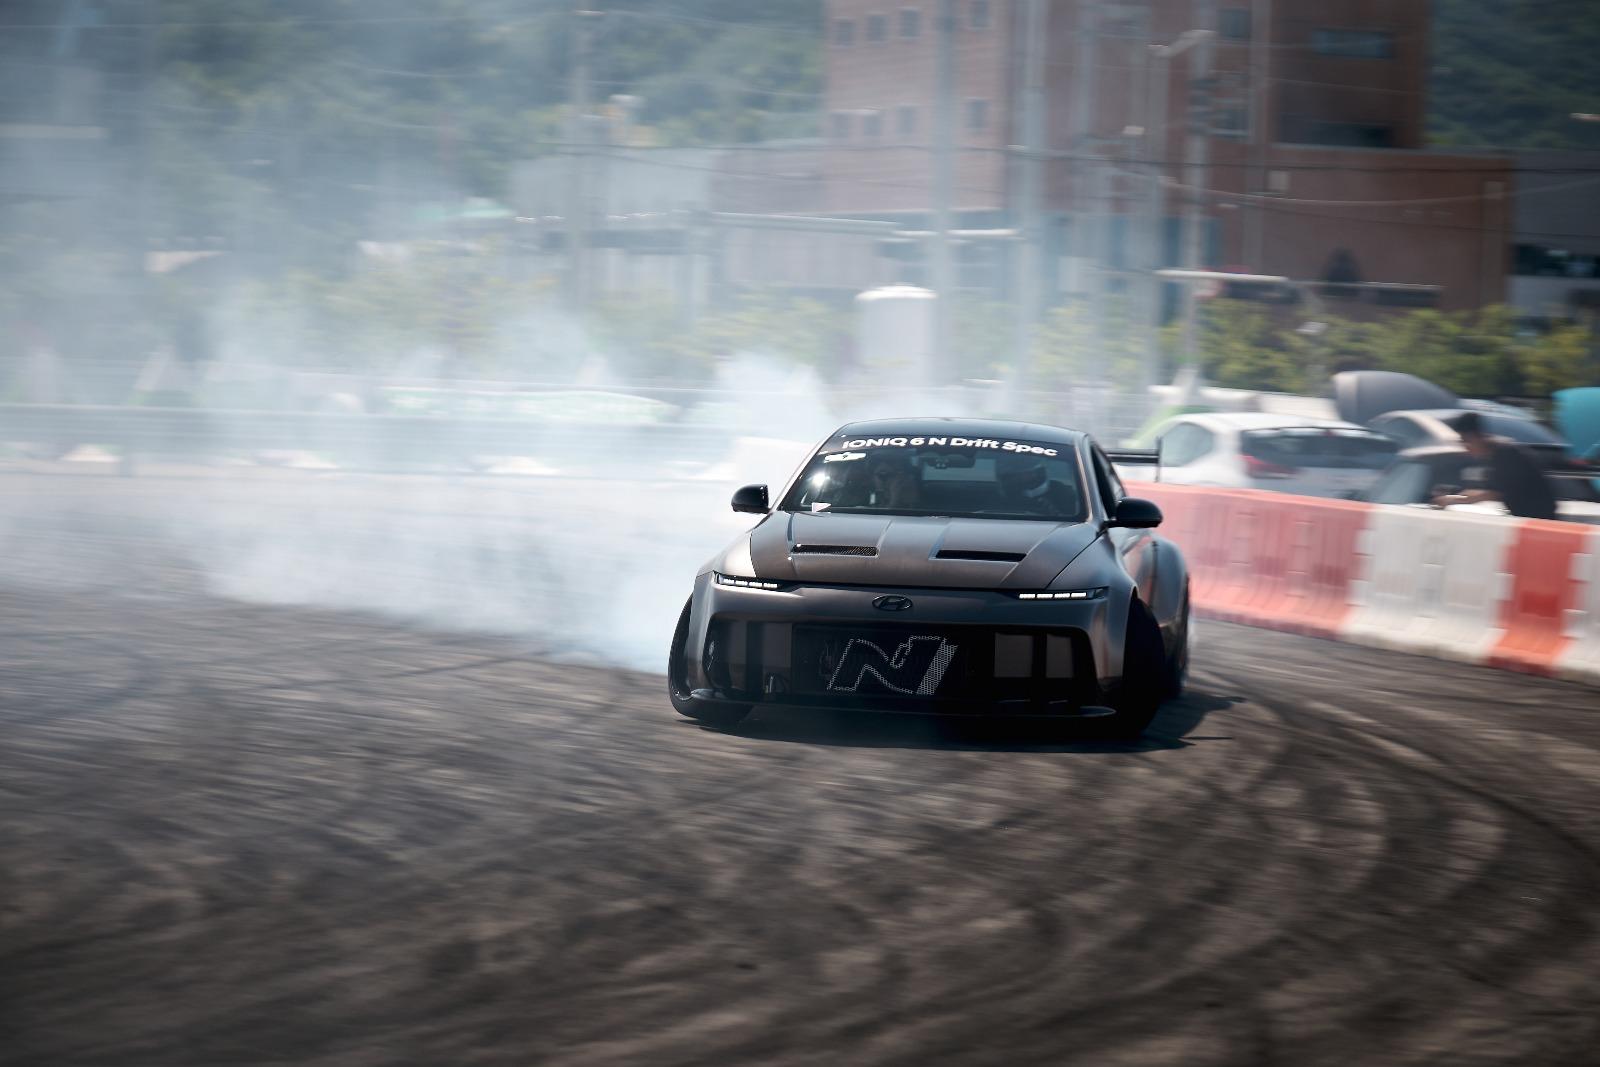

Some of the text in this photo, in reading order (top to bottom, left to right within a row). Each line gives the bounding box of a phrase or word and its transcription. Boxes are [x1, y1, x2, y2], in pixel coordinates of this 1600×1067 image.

[842, 437, 1058, 457] IONIQ 6 N Drift Spec
